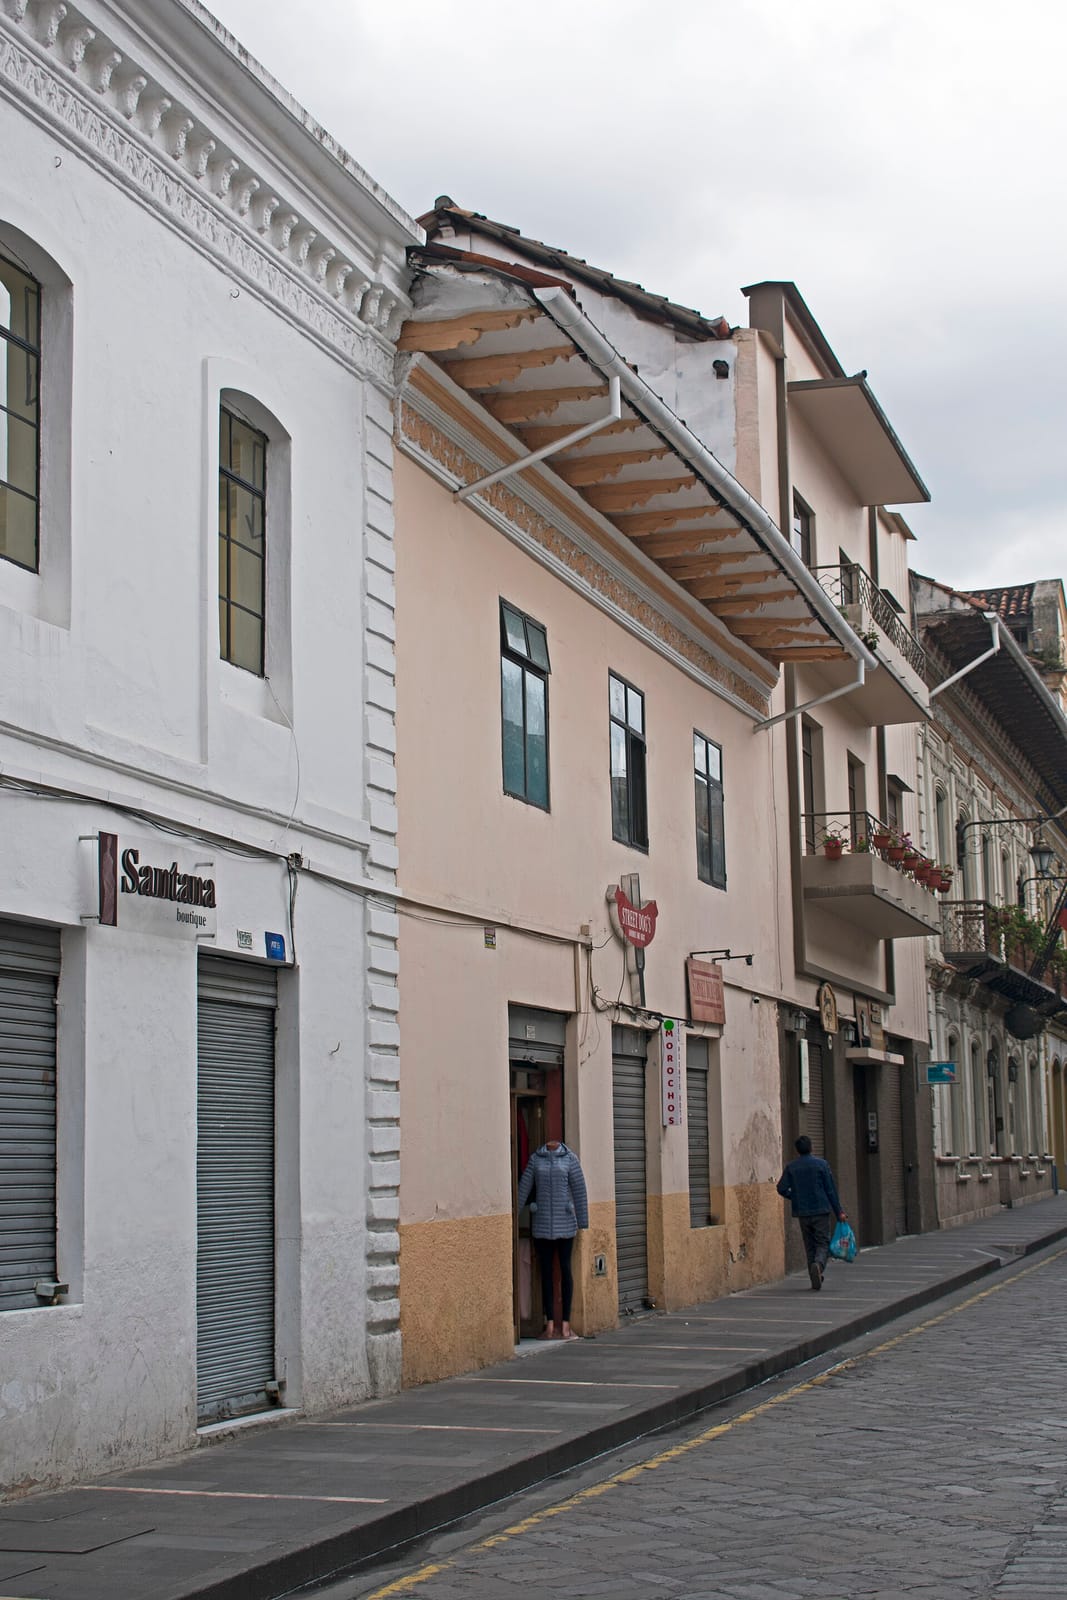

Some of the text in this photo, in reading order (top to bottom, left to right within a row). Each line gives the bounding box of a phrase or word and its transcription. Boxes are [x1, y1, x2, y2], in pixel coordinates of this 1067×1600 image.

[121, 848, 217, 908] Santana
[176, 907, 207, 929] boutique
[622, 907, 638, 929] STREET
[664, 1030, 676, 1126] MOROCHOS
